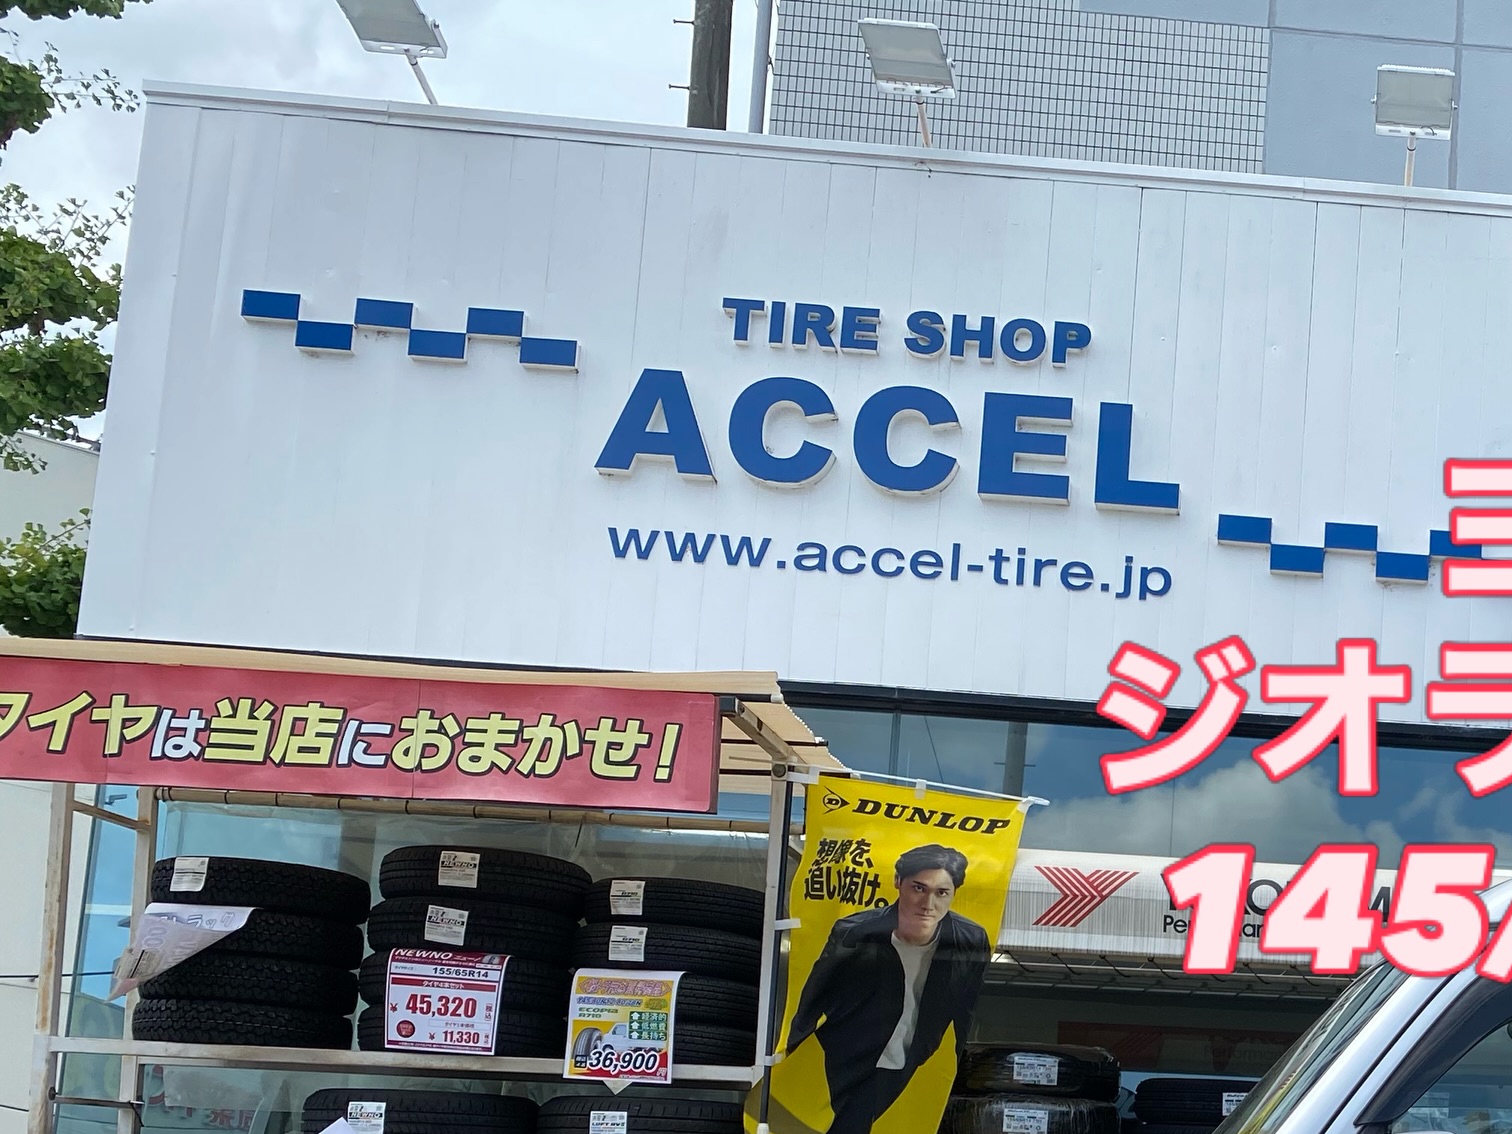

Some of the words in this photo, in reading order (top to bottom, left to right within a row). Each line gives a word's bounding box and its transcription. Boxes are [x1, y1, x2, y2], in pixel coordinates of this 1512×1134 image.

[722, 296, 882, 355] TIRE
[903, 310, 1092, 368] SHOP
[594, 368, 1181, 515] ACCEL
[608, 527, 1172, 601] www.accel-tire.jp
[852, 797, 1011, 835] DUNLOP
[812, 837, 874, 869] 想像を、
[804, 866, 889, 910] 追い抜け。
[395, 948, 453, 960] NEWNO
[432, 967, 489, 979] 155/65R14
[405, 993, 477, 1018] 45,320
[578, 1006, 618, 1014] ECOPIA
[442, 1030, 480, 1044] 11,330
[640, 1031, 667, 1040] 長持ち
[588, 1050, 658, 1074] 36,900
